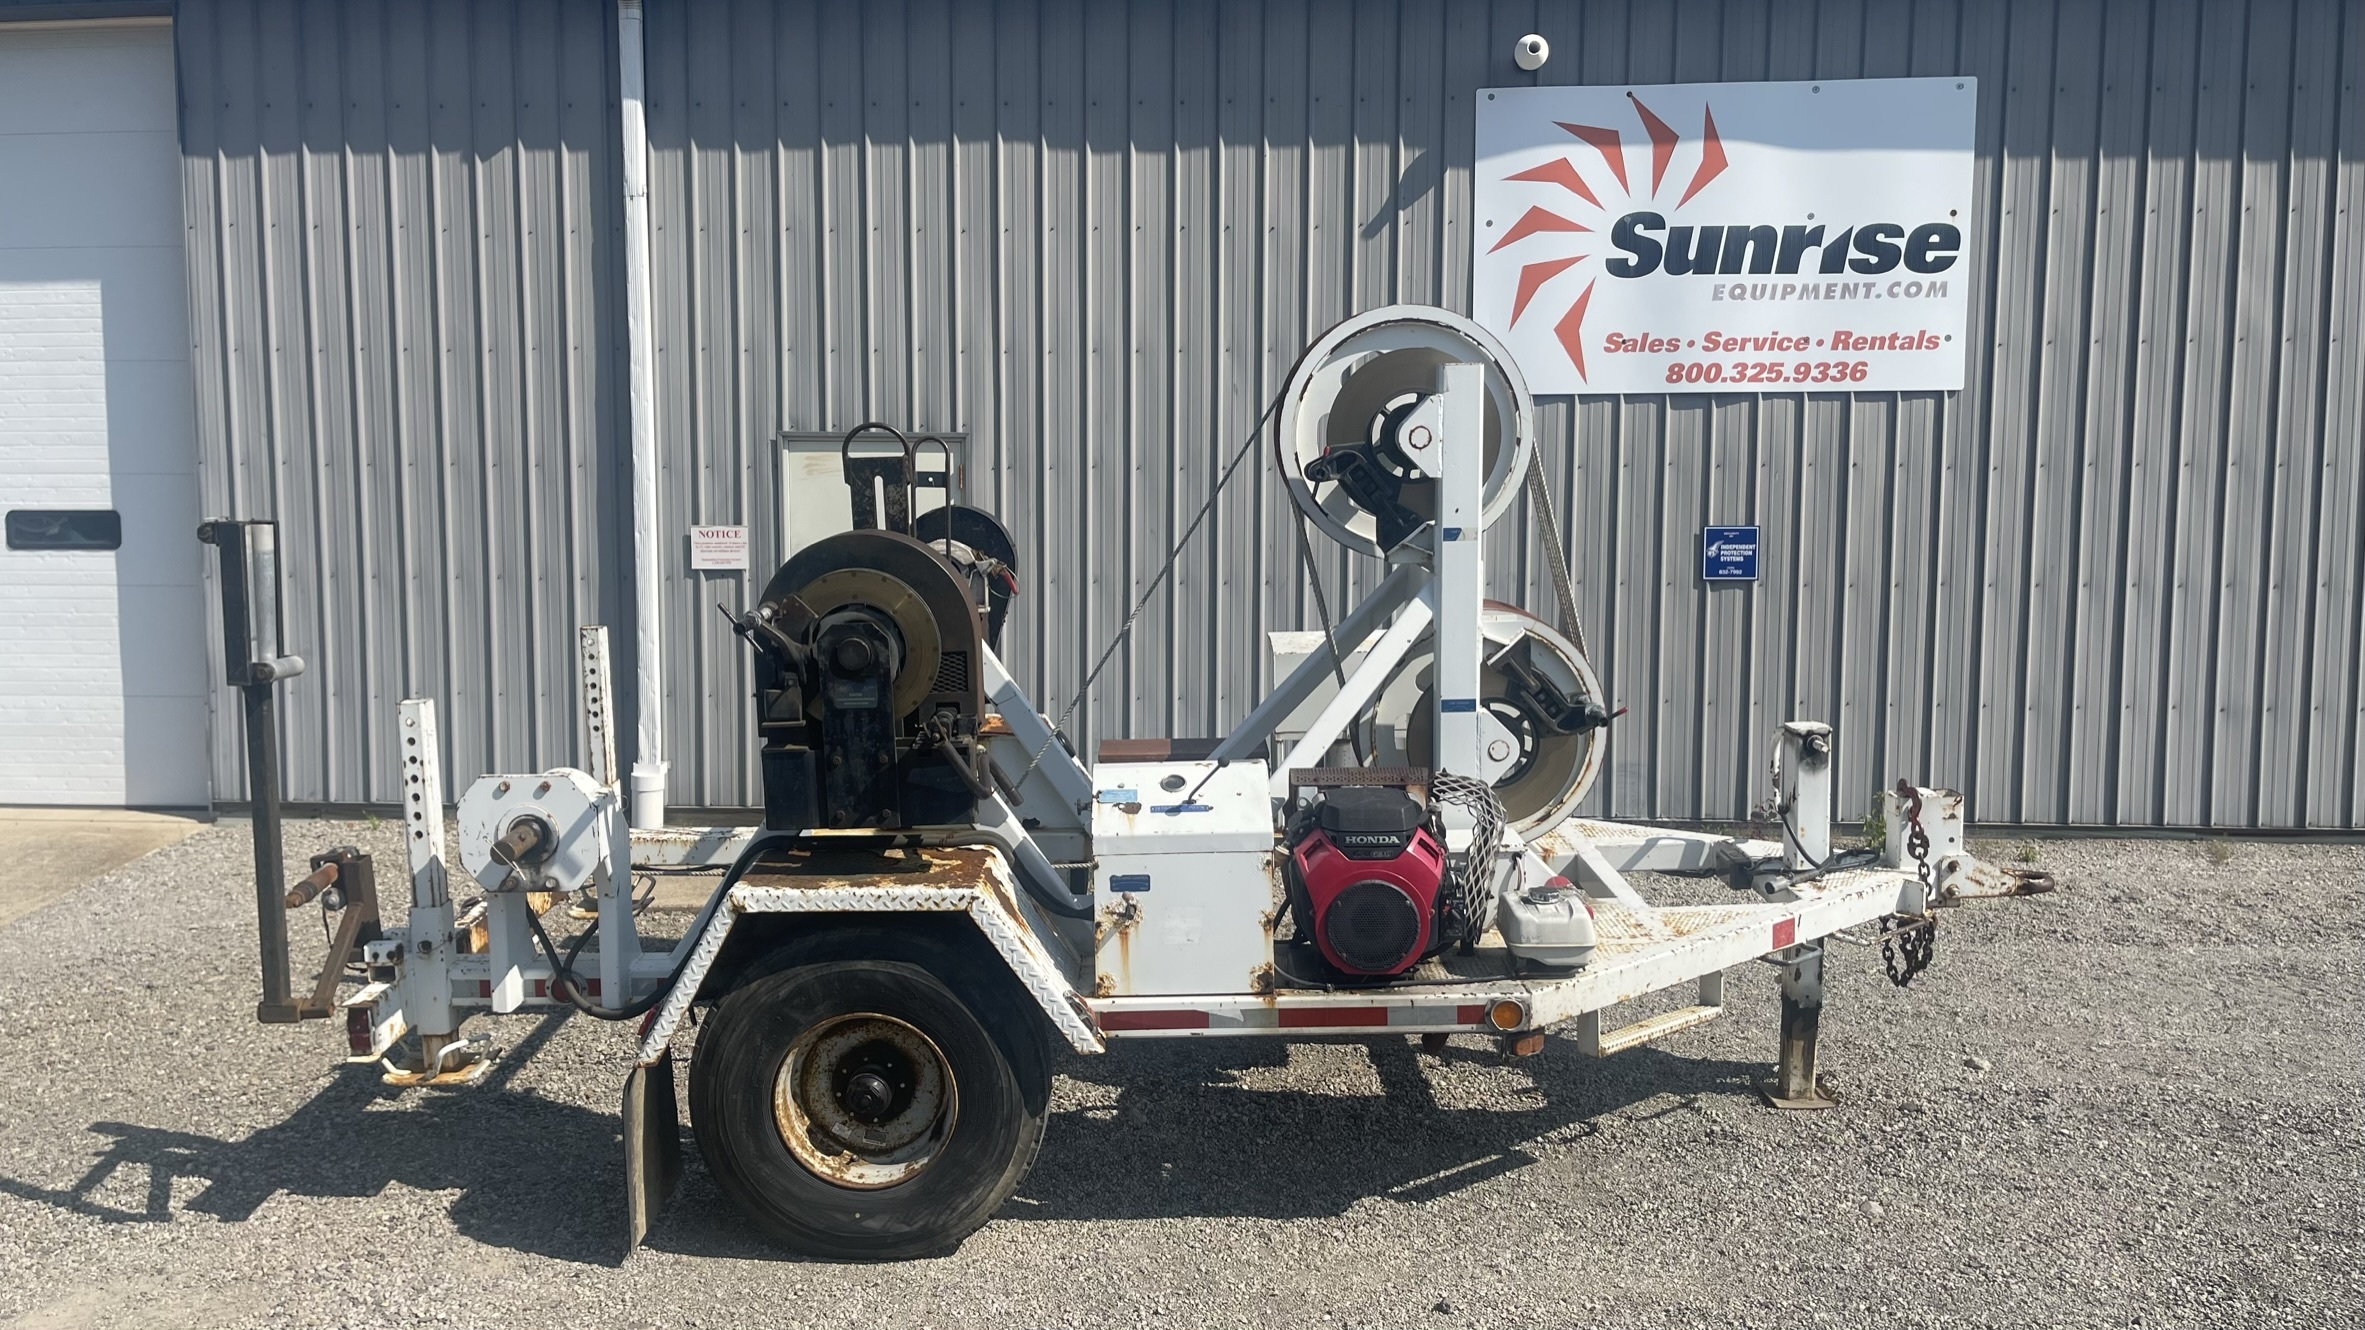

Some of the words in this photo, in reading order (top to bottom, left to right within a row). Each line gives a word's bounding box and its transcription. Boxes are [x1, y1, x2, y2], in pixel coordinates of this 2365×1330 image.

[1605, 211, 1962, 279] Sunrise
[1711, 281, 1948, 302] EQUIPMENT.COM
[1603, 332, 1681, 353] Sales
[1701, 331, 1810, 352] Service
[1830, 330, 1940, 351] Rentals
[1664, 361, 1868, 384] 800.325.9336
[698, 530, 741, 538] NOTICE
[1344, 835, 1401, 844] HONDA
